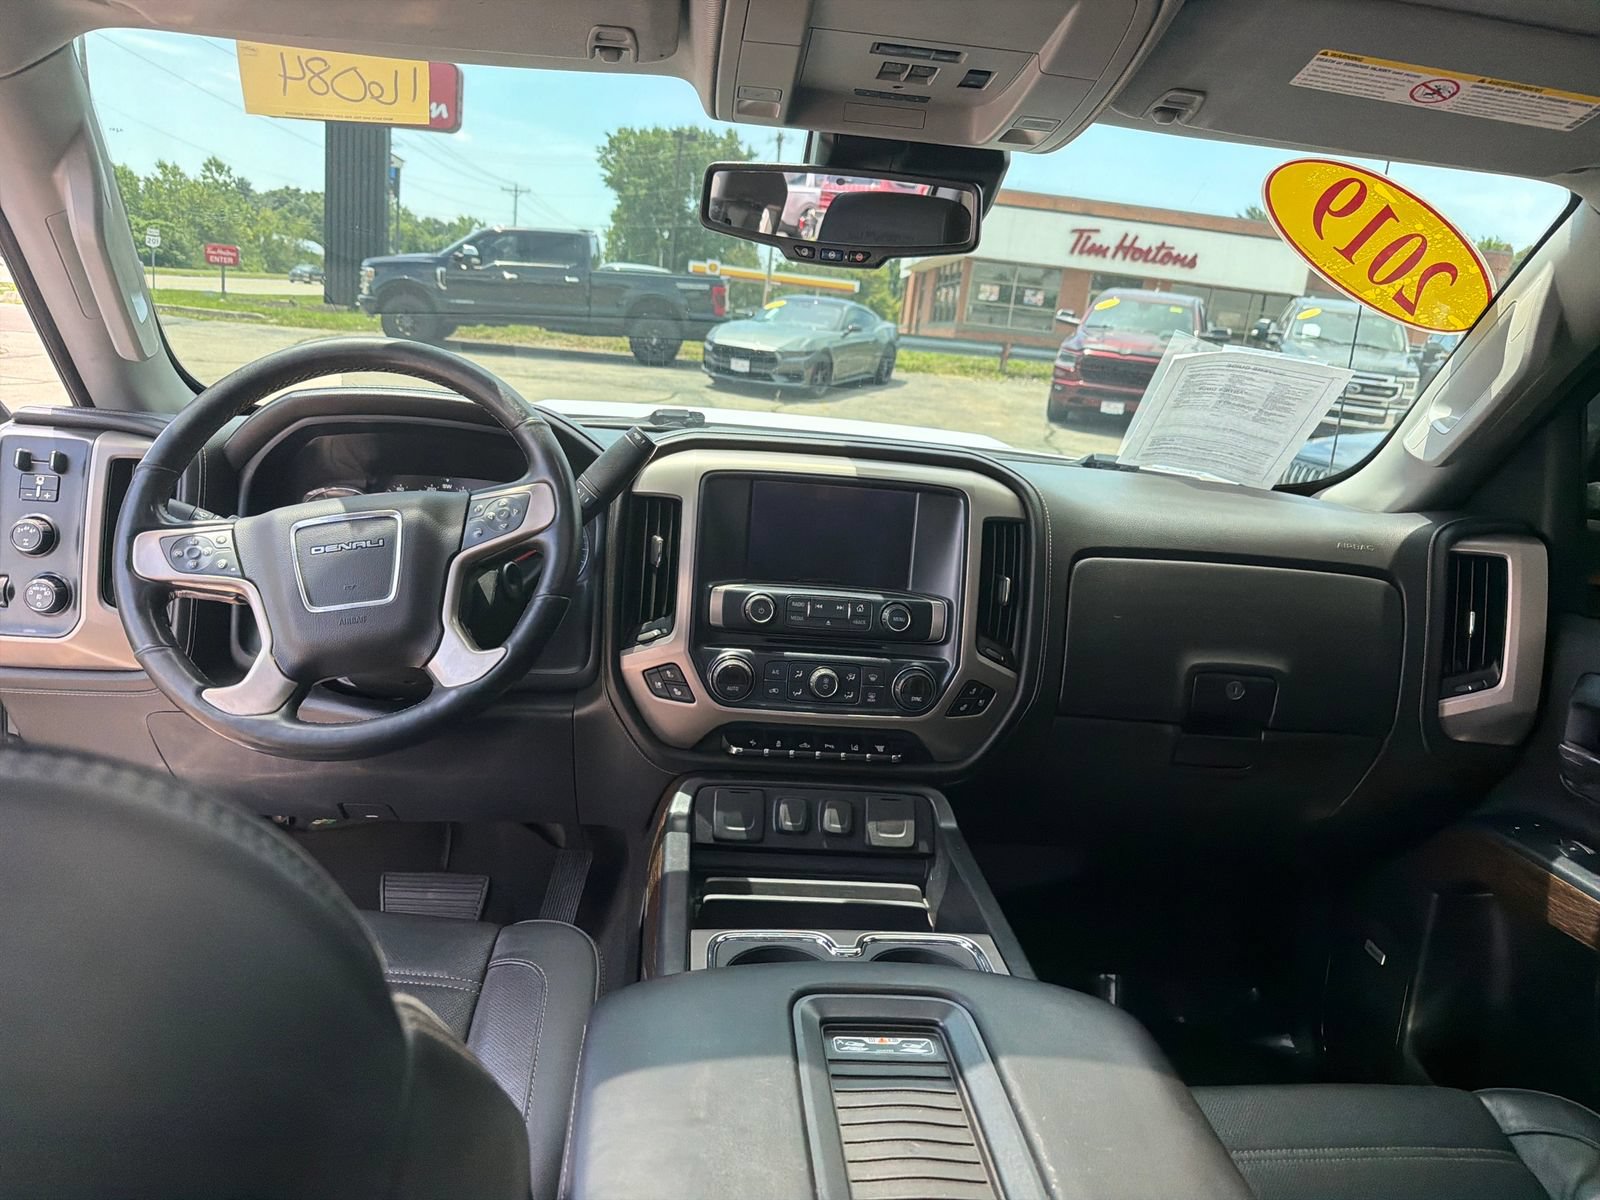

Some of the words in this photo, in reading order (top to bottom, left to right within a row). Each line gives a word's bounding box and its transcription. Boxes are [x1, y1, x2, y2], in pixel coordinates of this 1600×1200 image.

[147, 237, 160, 245] 201
[1070, 229, 1110, 258] Tim
[1112, 232, 1198, 269] Hortons
[209, 255, 234, 264] ENTER
[310, 538, 384, 555] DENALI
